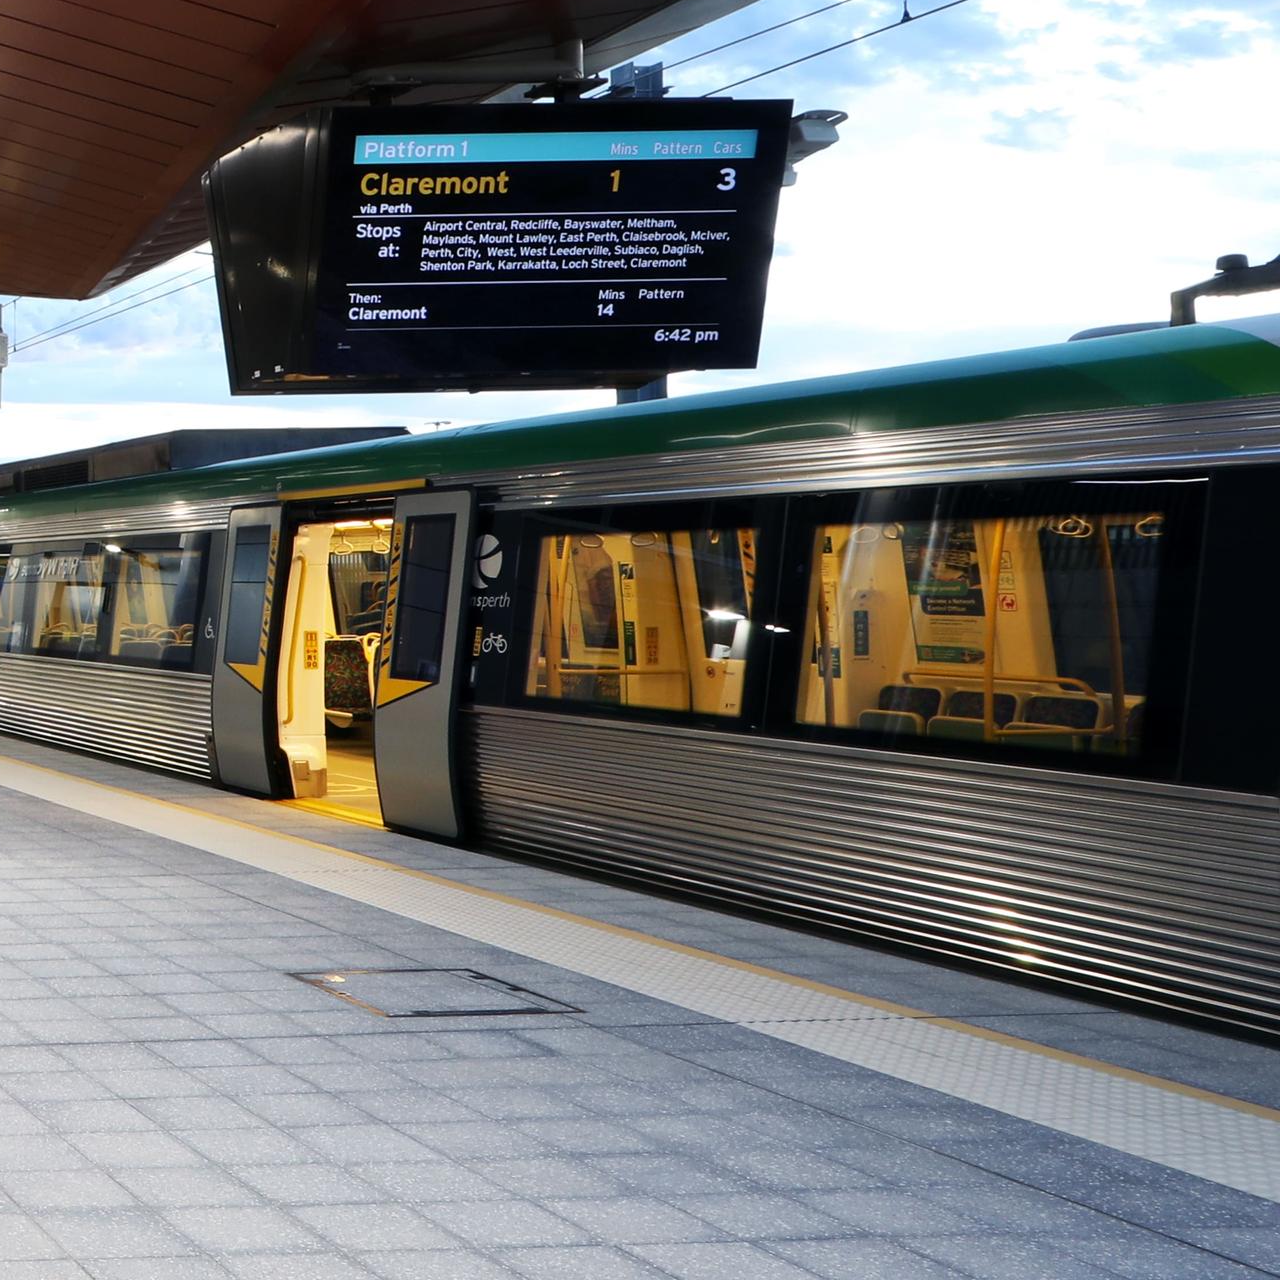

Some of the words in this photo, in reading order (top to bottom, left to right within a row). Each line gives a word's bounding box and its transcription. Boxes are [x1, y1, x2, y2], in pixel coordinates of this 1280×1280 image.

[364, 141, 455, 158] Platform
[460, 141, 469, 157] 1
[610, 142, 639, 156] Mins
[652, 141, 703, 155] Pattern
[713, 141, 742, 154] Cars
[360, 169, 509, 196] Claremont
[609, 169, 621, 192] 1
[716, 167, 737, 191] 3
[360, 203, 378, 215] via
[379, 202, 412, 215] Perth
[356, 223, 401, 241] Stops
[423, 220, 463, 233] Airport
[465, 220, 508, 231] Central,
[510, 218, 561, 231] Redcliffe,
[564, 218, 624, 231] Bayswater,
[627, 218, 677, 229] Meltham,
[422, 234, 476, 246] Maylands,
[479, 233, 514, 244] Mount
[516, 233, 557, 244] Lawley,
[559, 232, 584, 243] East
[586, 231, 619, 243] Perth,
[622, 230, 688, 242] Claisebrook,
[378, 243, 400, 259] at:
[421, 247, 454, 259] Perth,
[456, 246, 481, 259] City,
[487, 246, 517, 258] West,
[519, 245, 547, 257] West
[549, 245, 611, 257] Leederville,
[614, 244, 660, 256] Subiaco,
[662, 243, 704, 256] Daglish,
[420, 260, 465, 271] Shenton
[467, 260, 495, 271] Park,
[497, 259, 559, 271] Karrakatta,
[561, 258, 588, 269] Loch
[591, 258, 627, 269] Street,
[630, 257, 687, 268] Claremont
[349, 292, 382, 304] Then:
[598, 288, 625, 300] Mins
[639, 288, 684, 300] Pattern
[348, 306, 427, 320] Claremont
[597, 303, 614, 317] 14
[654, 328, 691, 342] 6:42
[694, 330, 719, 344] pm
